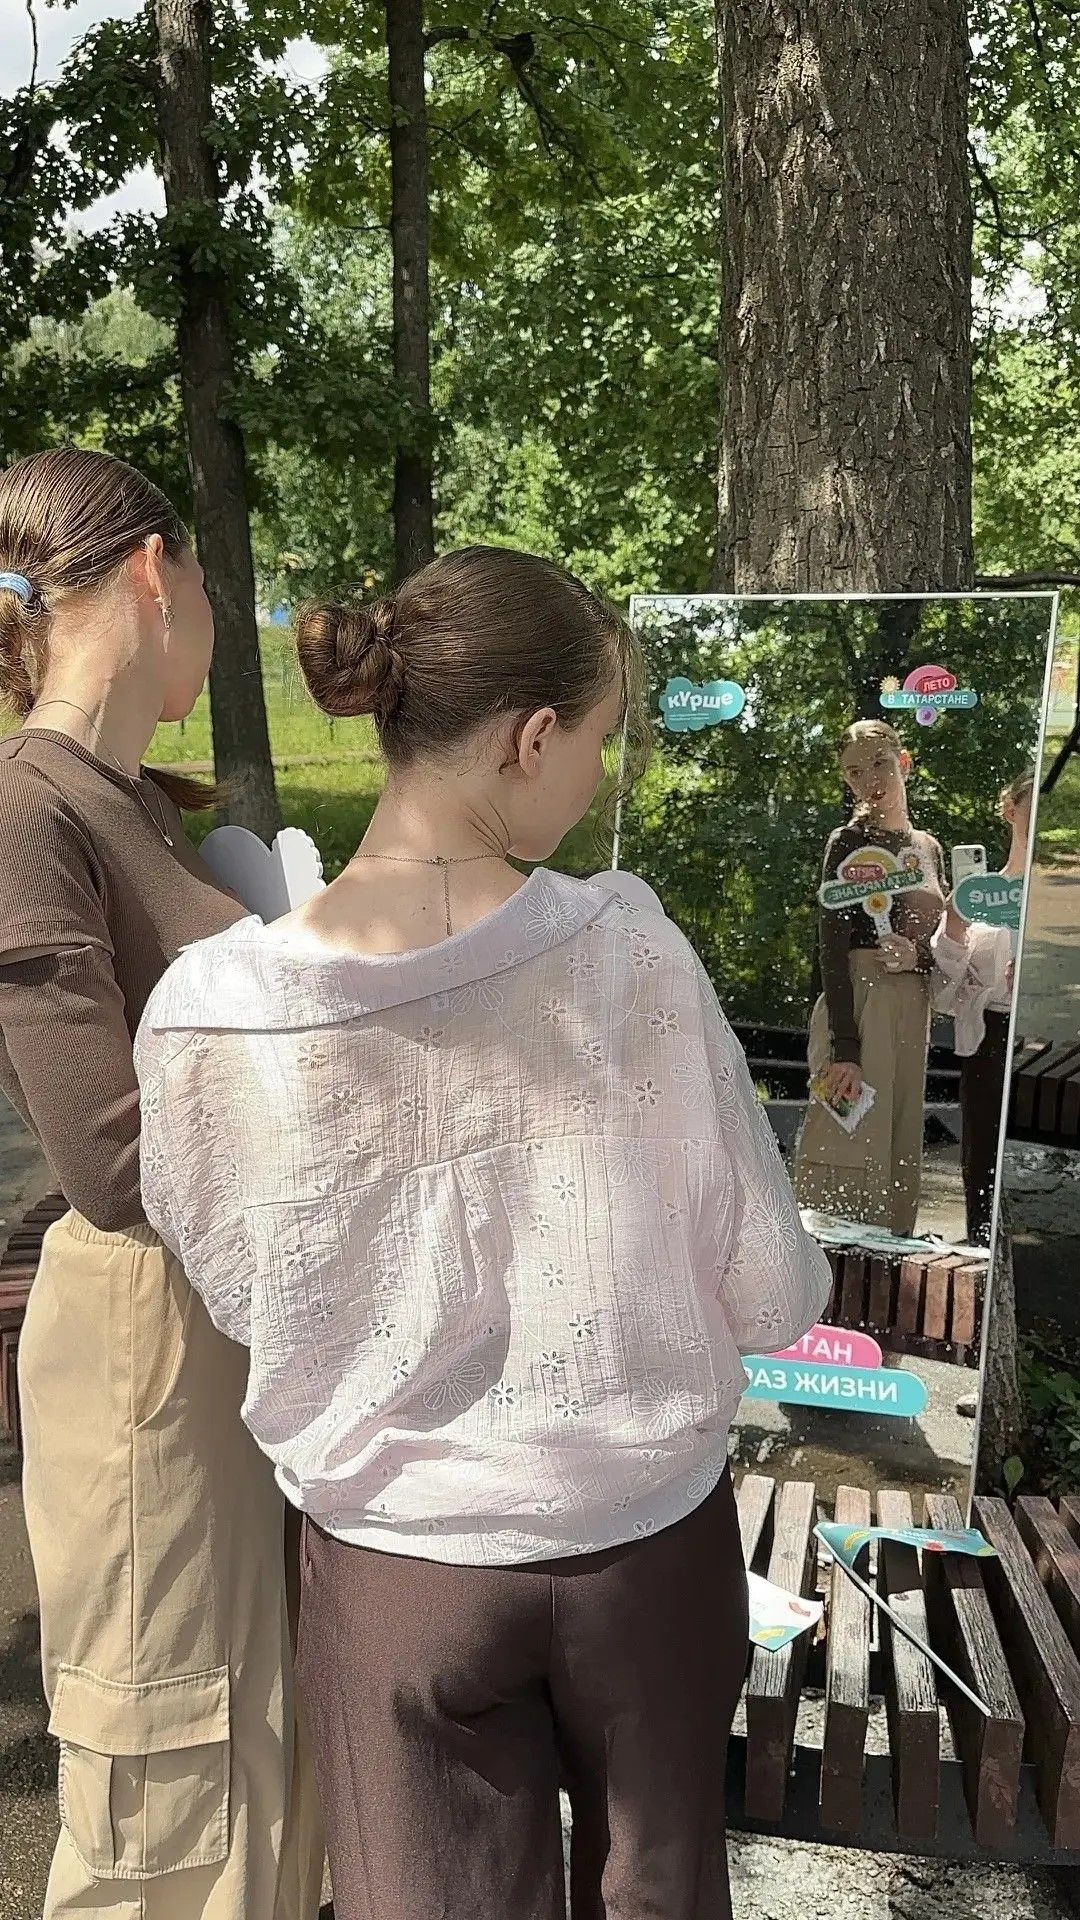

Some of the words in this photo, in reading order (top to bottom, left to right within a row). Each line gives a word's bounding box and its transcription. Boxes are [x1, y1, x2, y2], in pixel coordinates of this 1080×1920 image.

[923, 677, 951, 693] ЛЕТО
[887, 694, 896, 705] В
[902, 694, 969, 705] ТАТАРСТАНЕ
[787, 1334, 853, 1364] ТАН
[794, 1371, 898, 1403] ЖИЗНИ
